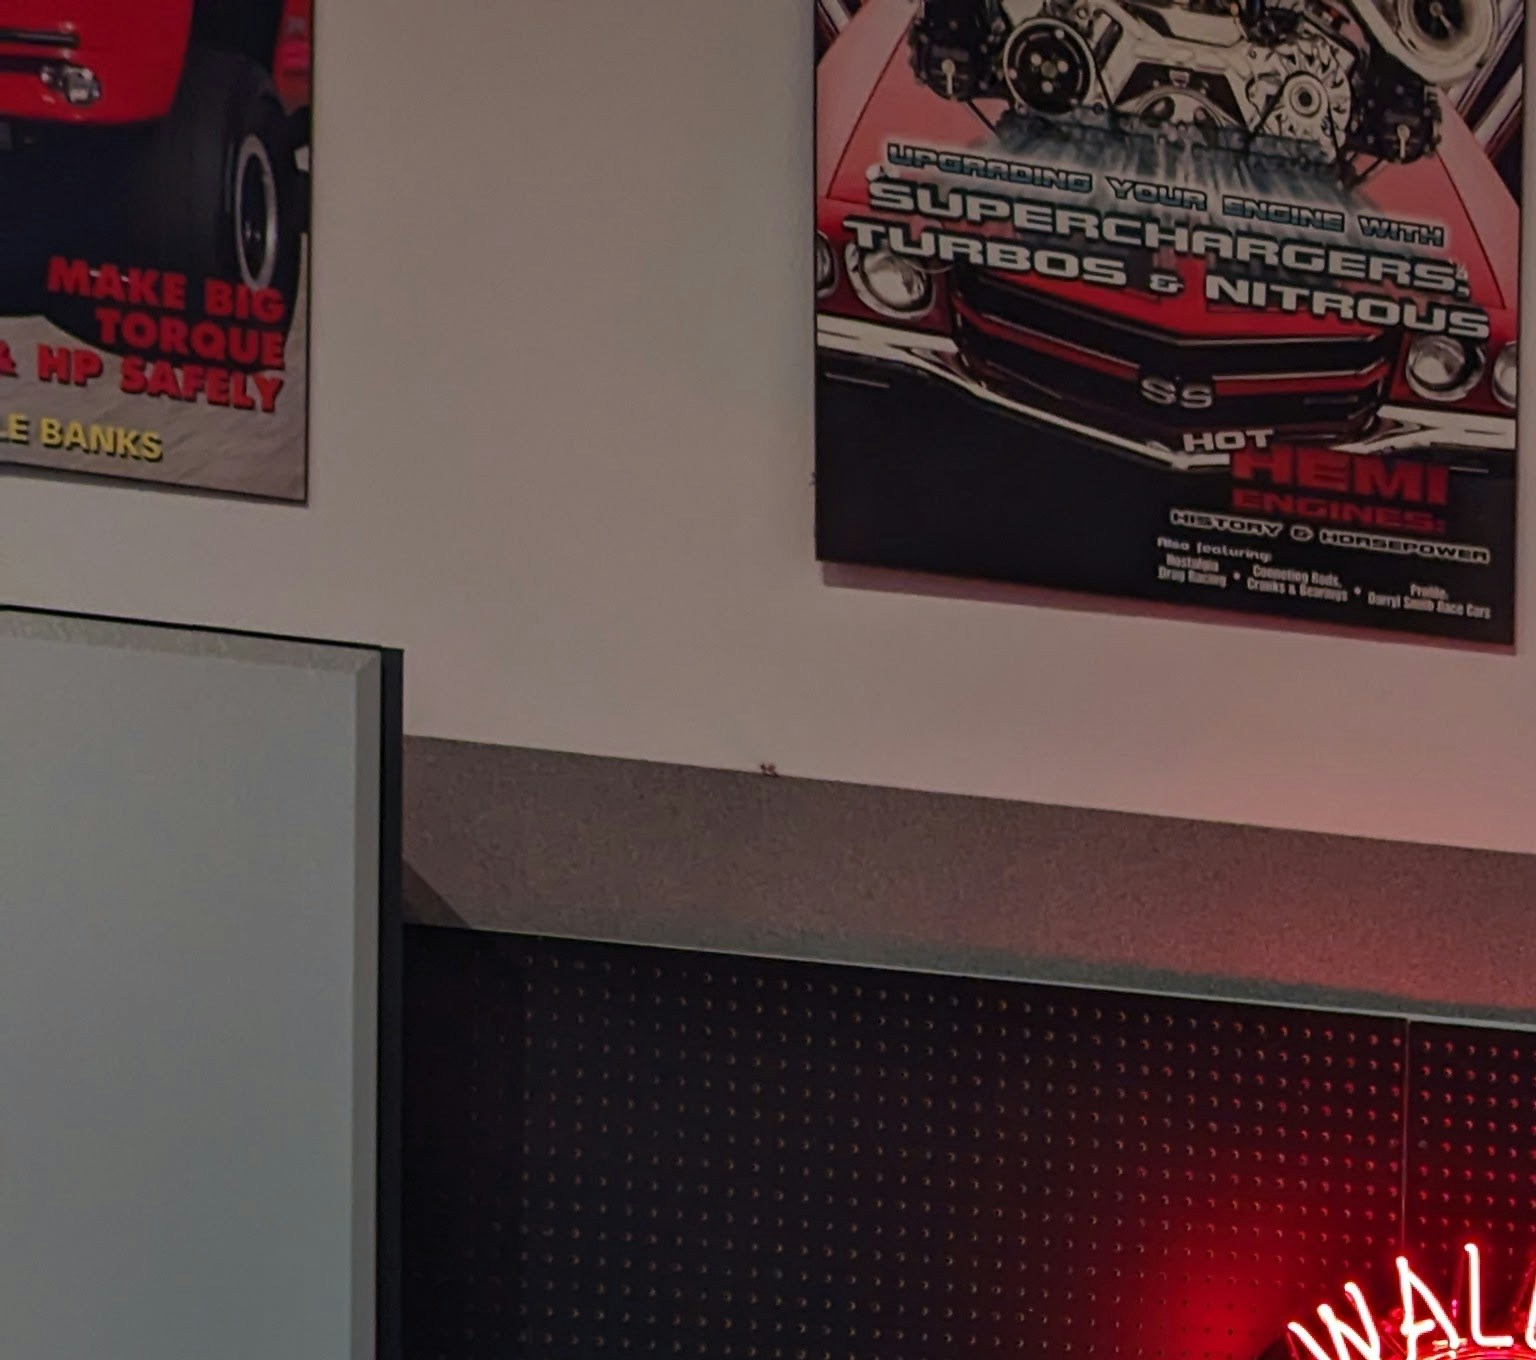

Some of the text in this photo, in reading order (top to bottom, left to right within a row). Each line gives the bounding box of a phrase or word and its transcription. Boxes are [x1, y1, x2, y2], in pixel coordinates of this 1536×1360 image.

[887, 142, 1444, 247] UPGRADING YOUR ENGINE WITH
[47, 255, 285, 324] MAKE BIG
[843, 218, 1491, 340] TURBOS & NITROUS
[95, 307, 286, 371] TORQUE
[37, 343, 104, 388] HP
[120, 355, 284, 414] SAFELY
[1140, 375, 1214, 410] SS
[39, 417, 163, 463] BANKS
[1183, 429, 1274, 451] HOT
[1231, 443, 1450, 506] HEMI
[1170, 508, 1283, 536] HISTORY
[1319, 529, 1491, 564] HORSEPOWER
